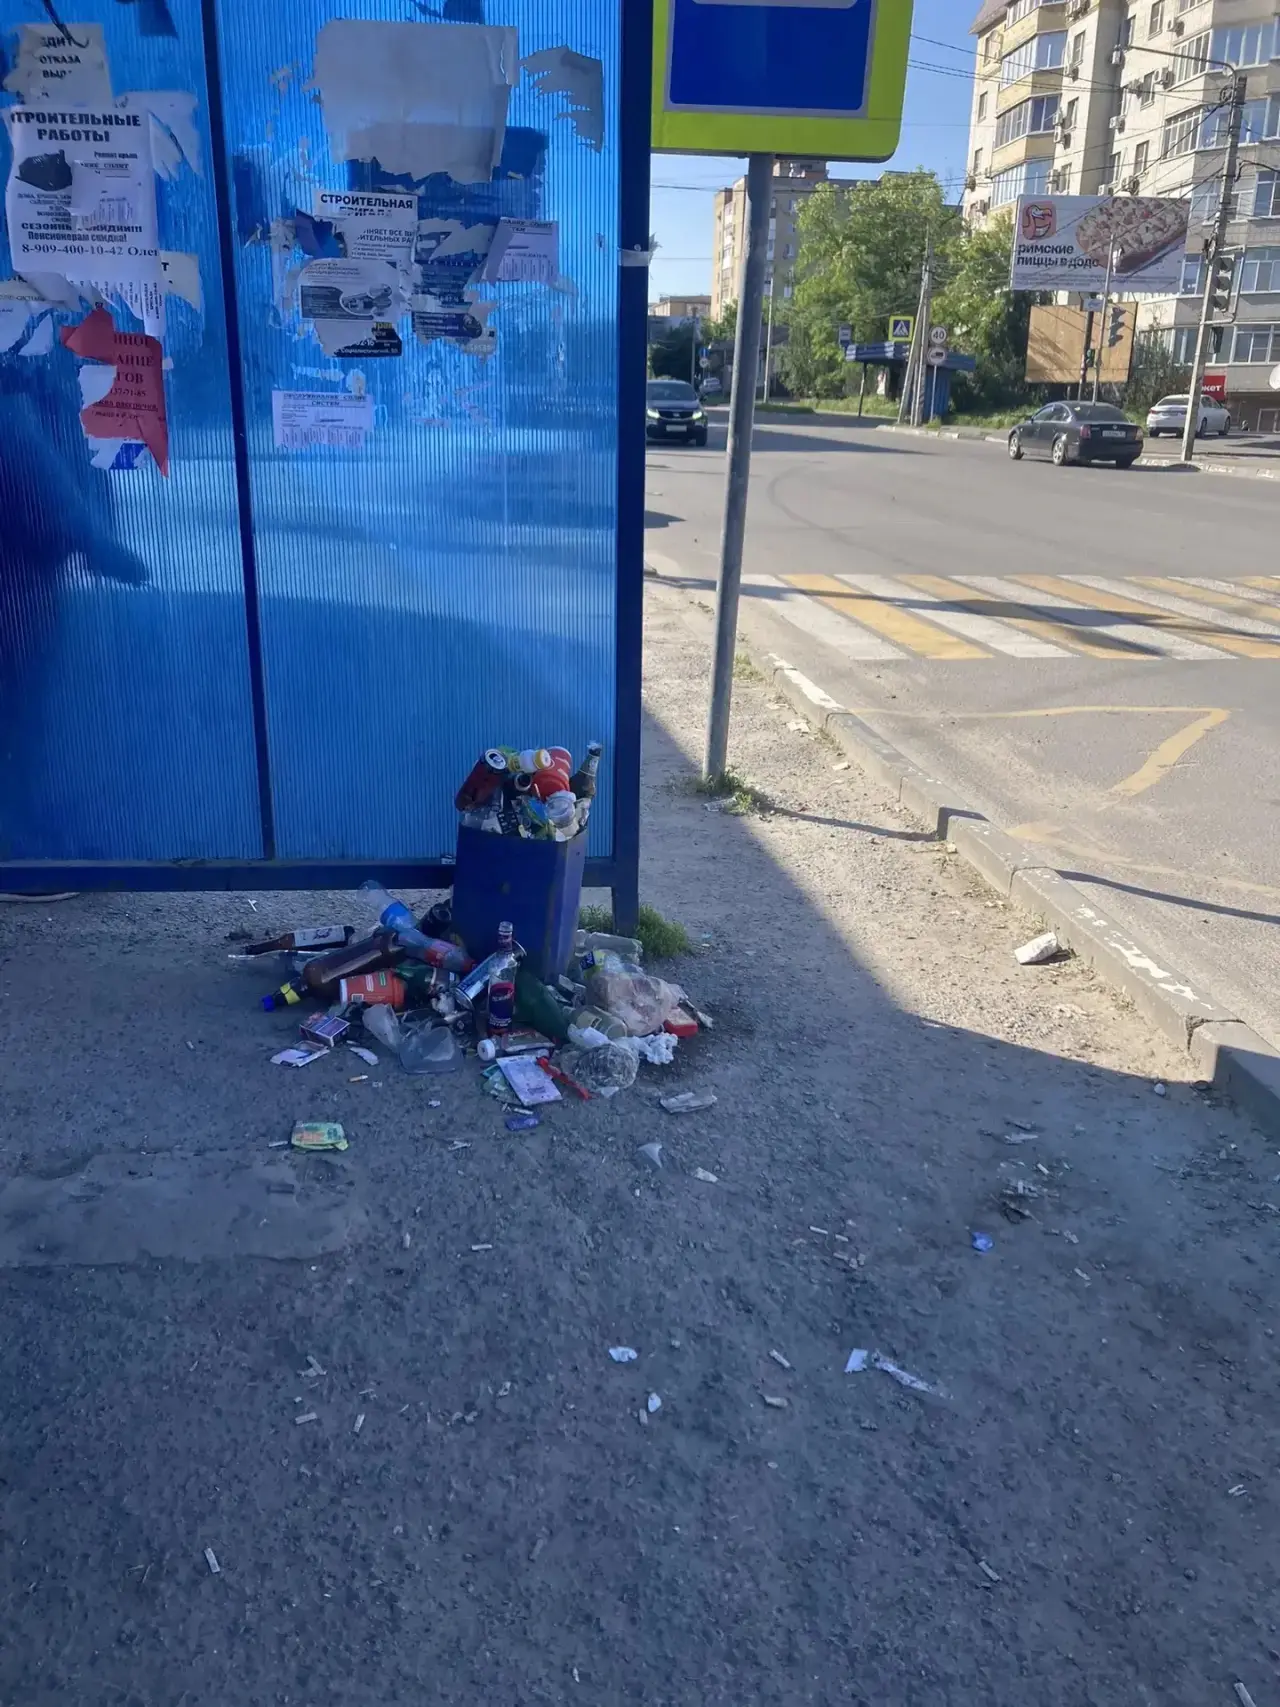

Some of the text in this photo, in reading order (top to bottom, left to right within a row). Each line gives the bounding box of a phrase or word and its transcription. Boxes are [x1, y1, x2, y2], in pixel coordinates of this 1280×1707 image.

[40, 55, 81, 64] ОТКАЗА
[37, 128, 110, 143] РАБОТЫ
[320, 194, 413, 209] СТРОИТЕЛЬНАЯ
[28, 231, 90, 242] Пенсионерам
[22, 244, 124, 256] 8-909-400-10-42
[1018, 243, 1074, 255] римские
[1016, 255, 1101, 268] пиццы в додо
[933, 331, 945, 340] 40
